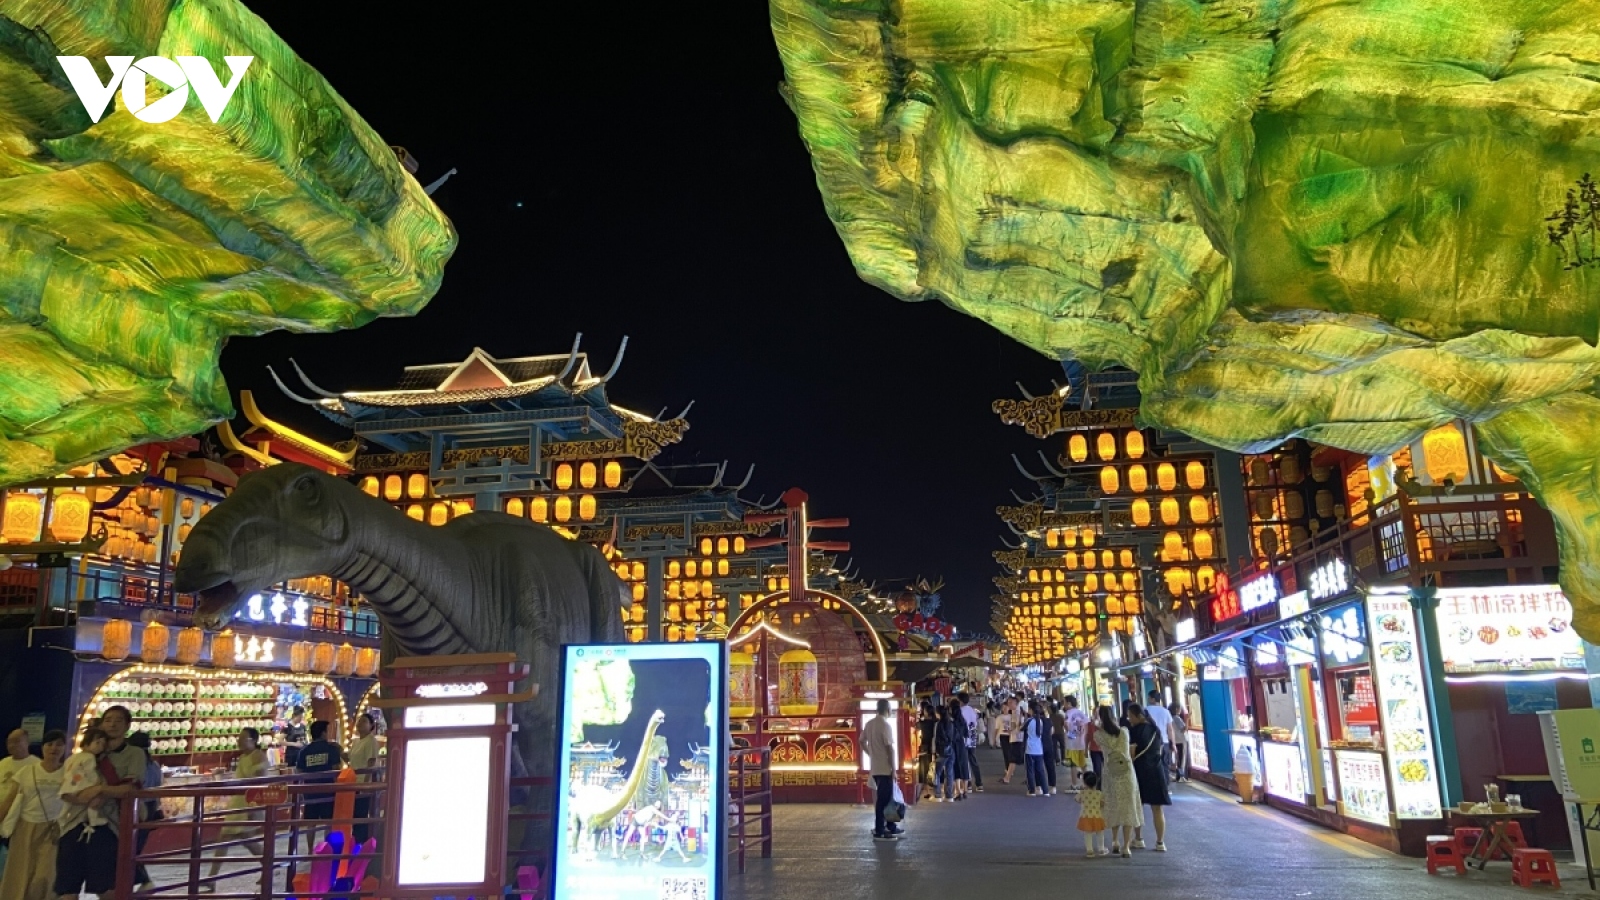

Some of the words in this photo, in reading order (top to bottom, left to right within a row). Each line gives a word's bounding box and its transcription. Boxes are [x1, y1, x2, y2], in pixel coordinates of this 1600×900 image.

[1447, 592, 1568, 615] 玉林凉拌粉
